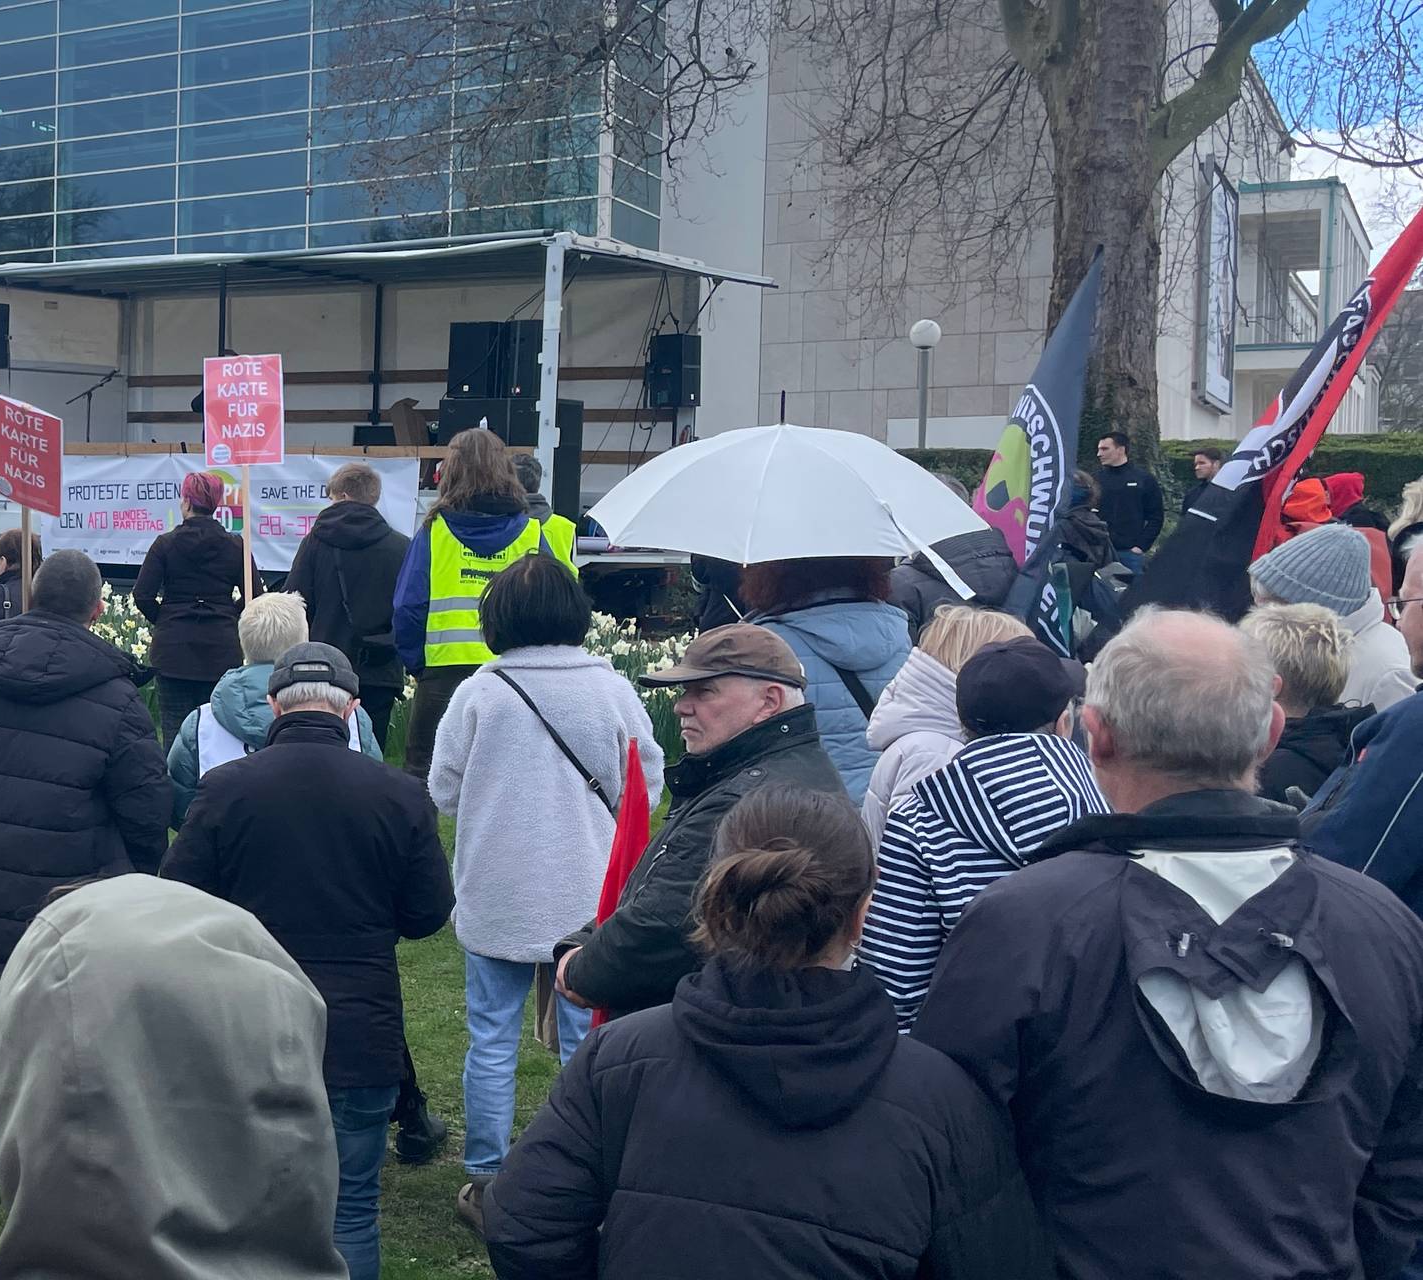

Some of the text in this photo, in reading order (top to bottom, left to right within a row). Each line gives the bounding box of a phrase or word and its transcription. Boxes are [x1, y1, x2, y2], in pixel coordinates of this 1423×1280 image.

[222, 362, 263, 377] ROTE
[217, 382, 269, 398] KARTE
[228, 399, 258, 418] FÜR
[4, 405, 44, 432] ROTE
[0, 423, 49, 453] KARTE
[222, 422, 266, 439] NAZIS
[10, 446, 39, 468] FÜR
[4, 462, 46, 489] NAZIS
[68, 484, 130, 501] PROTESTE
[137, 482, 181, 501] GEGEN
[260, 486, 289, 500] SAVE
[292, 485, 316, 499] THE
[59, 511, 108, 529] DEN AFD
[113, 508, 152, 521] BUNDES-
[113, 519, 164, 531] PARTEITAG
